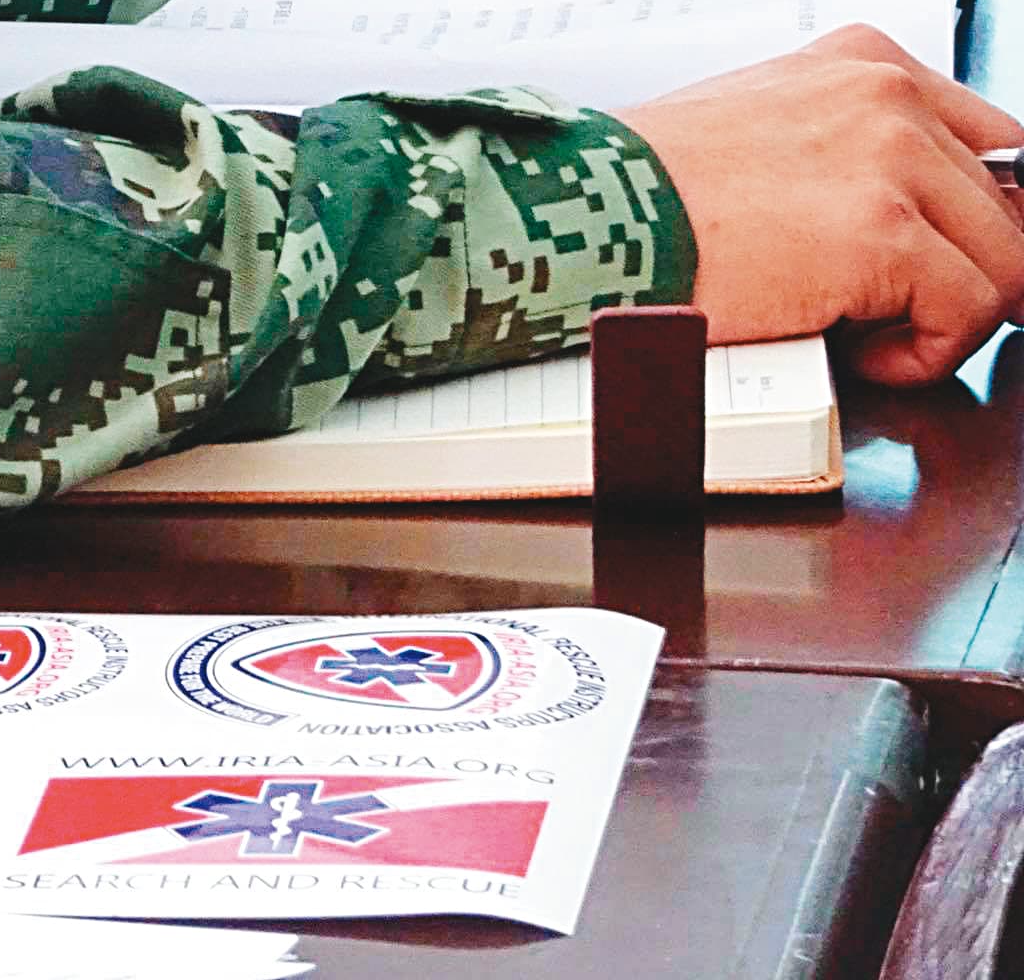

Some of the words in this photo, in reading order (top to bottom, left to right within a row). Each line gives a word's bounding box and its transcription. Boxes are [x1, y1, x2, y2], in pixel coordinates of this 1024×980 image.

[542, 637, 606, 682] RESCUE
[494, 680, 608, 728] INSTRUCTORS
[296, 719, 491, 737] ASSOCIATION
[59, 752, 556, 786] WWW.IRIA-ASIA.ORG
[3, 873, 190, 891] SEARCH
[207, 873, 320, 892] AND
[339, 873, 522, 900] RESCUE
